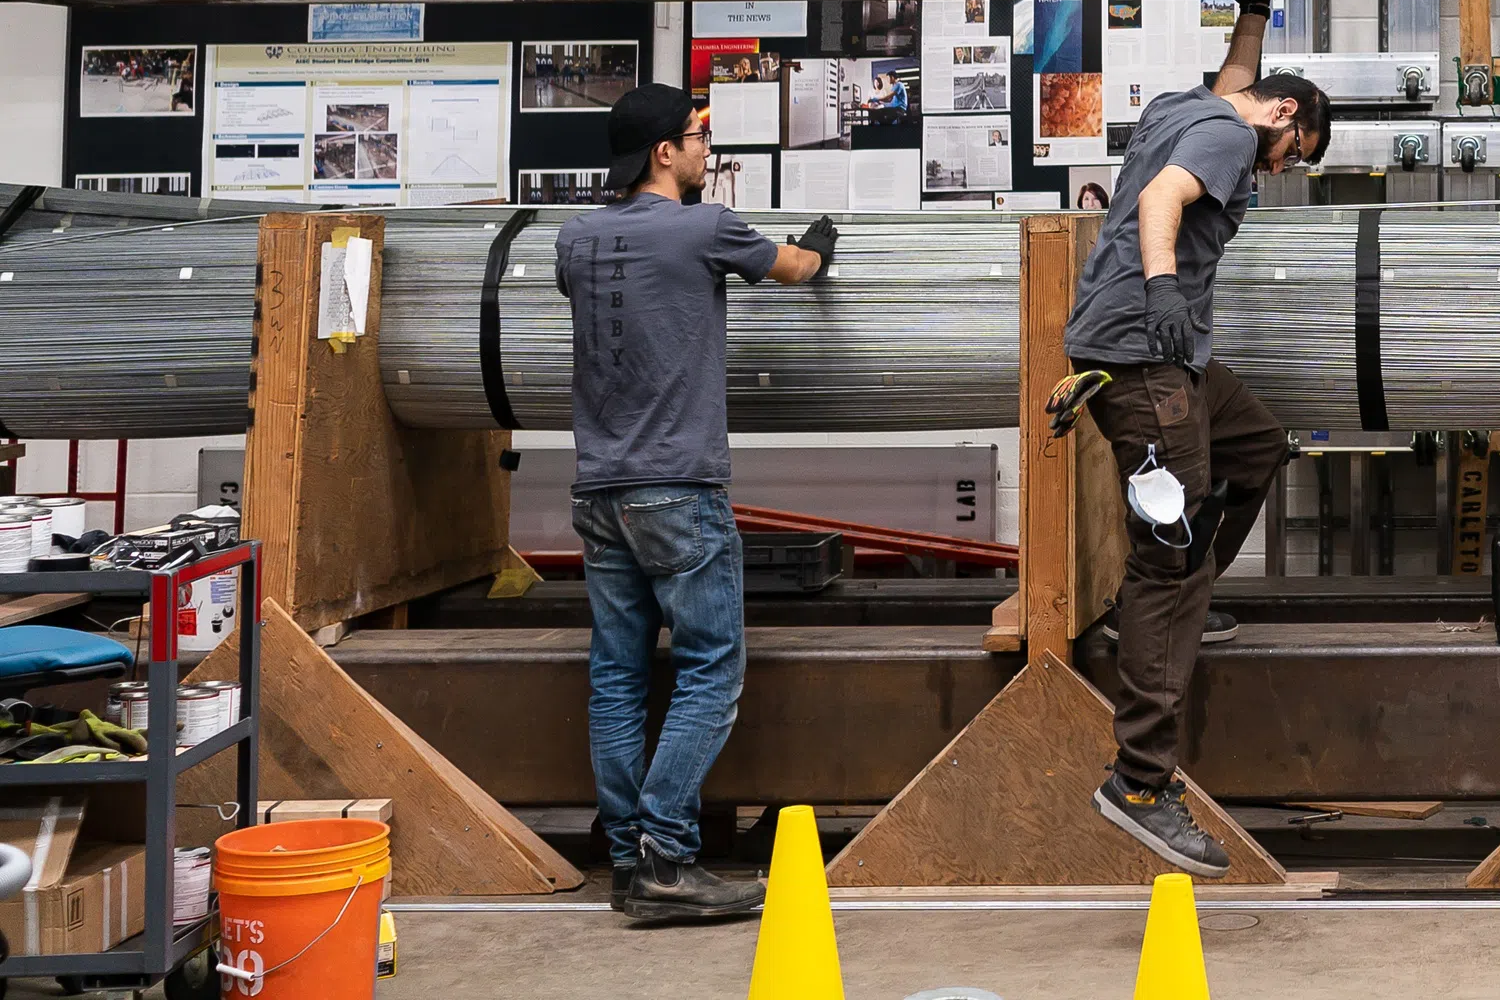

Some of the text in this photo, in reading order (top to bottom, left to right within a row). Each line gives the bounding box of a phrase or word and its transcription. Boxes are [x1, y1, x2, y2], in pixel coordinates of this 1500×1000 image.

[745, 1, 754, 9] IN
[746, 14, 771, 22] NEWS
[610, 235, 628, 366] LABBY
[956, 480, 976, 521] LAB
